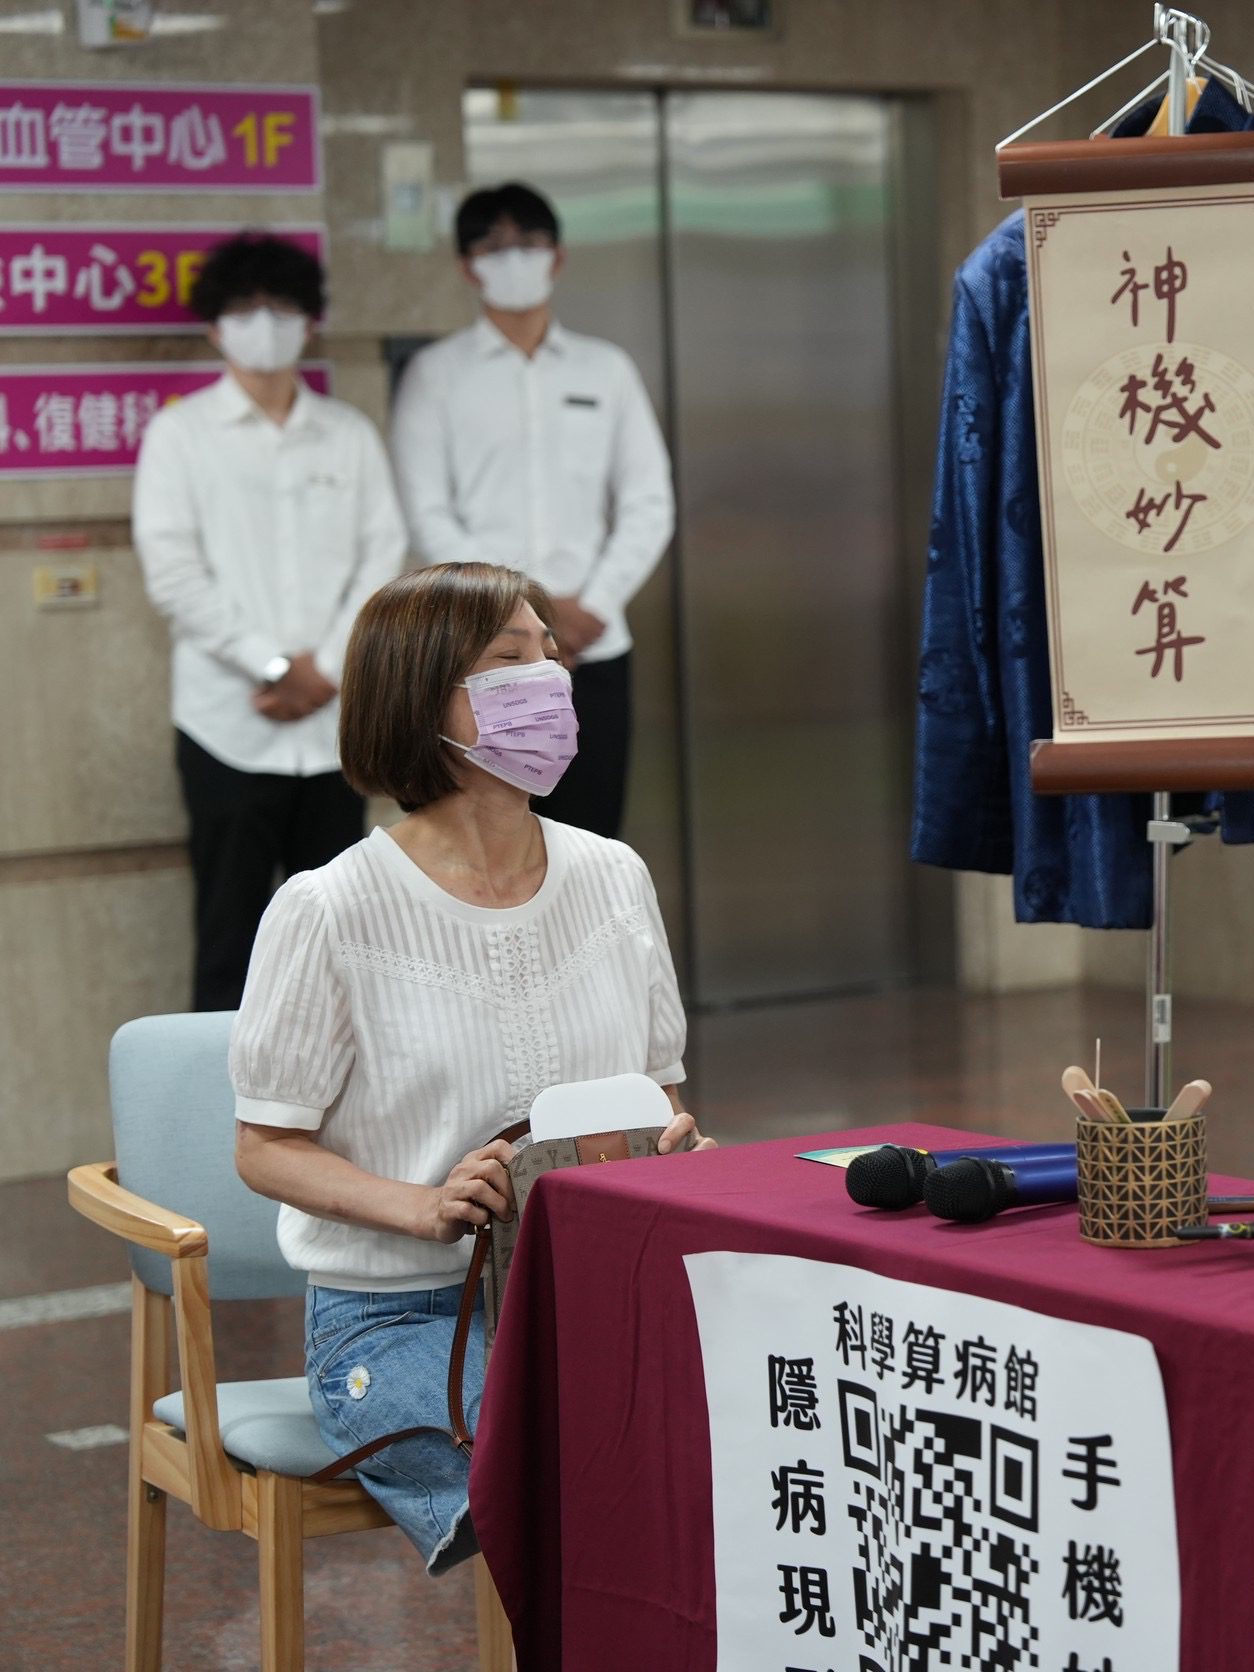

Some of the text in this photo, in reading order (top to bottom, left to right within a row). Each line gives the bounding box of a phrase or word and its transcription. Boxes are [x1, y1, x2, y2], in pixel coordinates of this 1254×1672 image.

[1111, 246, 1222, 682] 神機妙算
[767, 1354, 837, 1672] 隱病現
[832, 1301, 1039, 1422] 科學算病館
